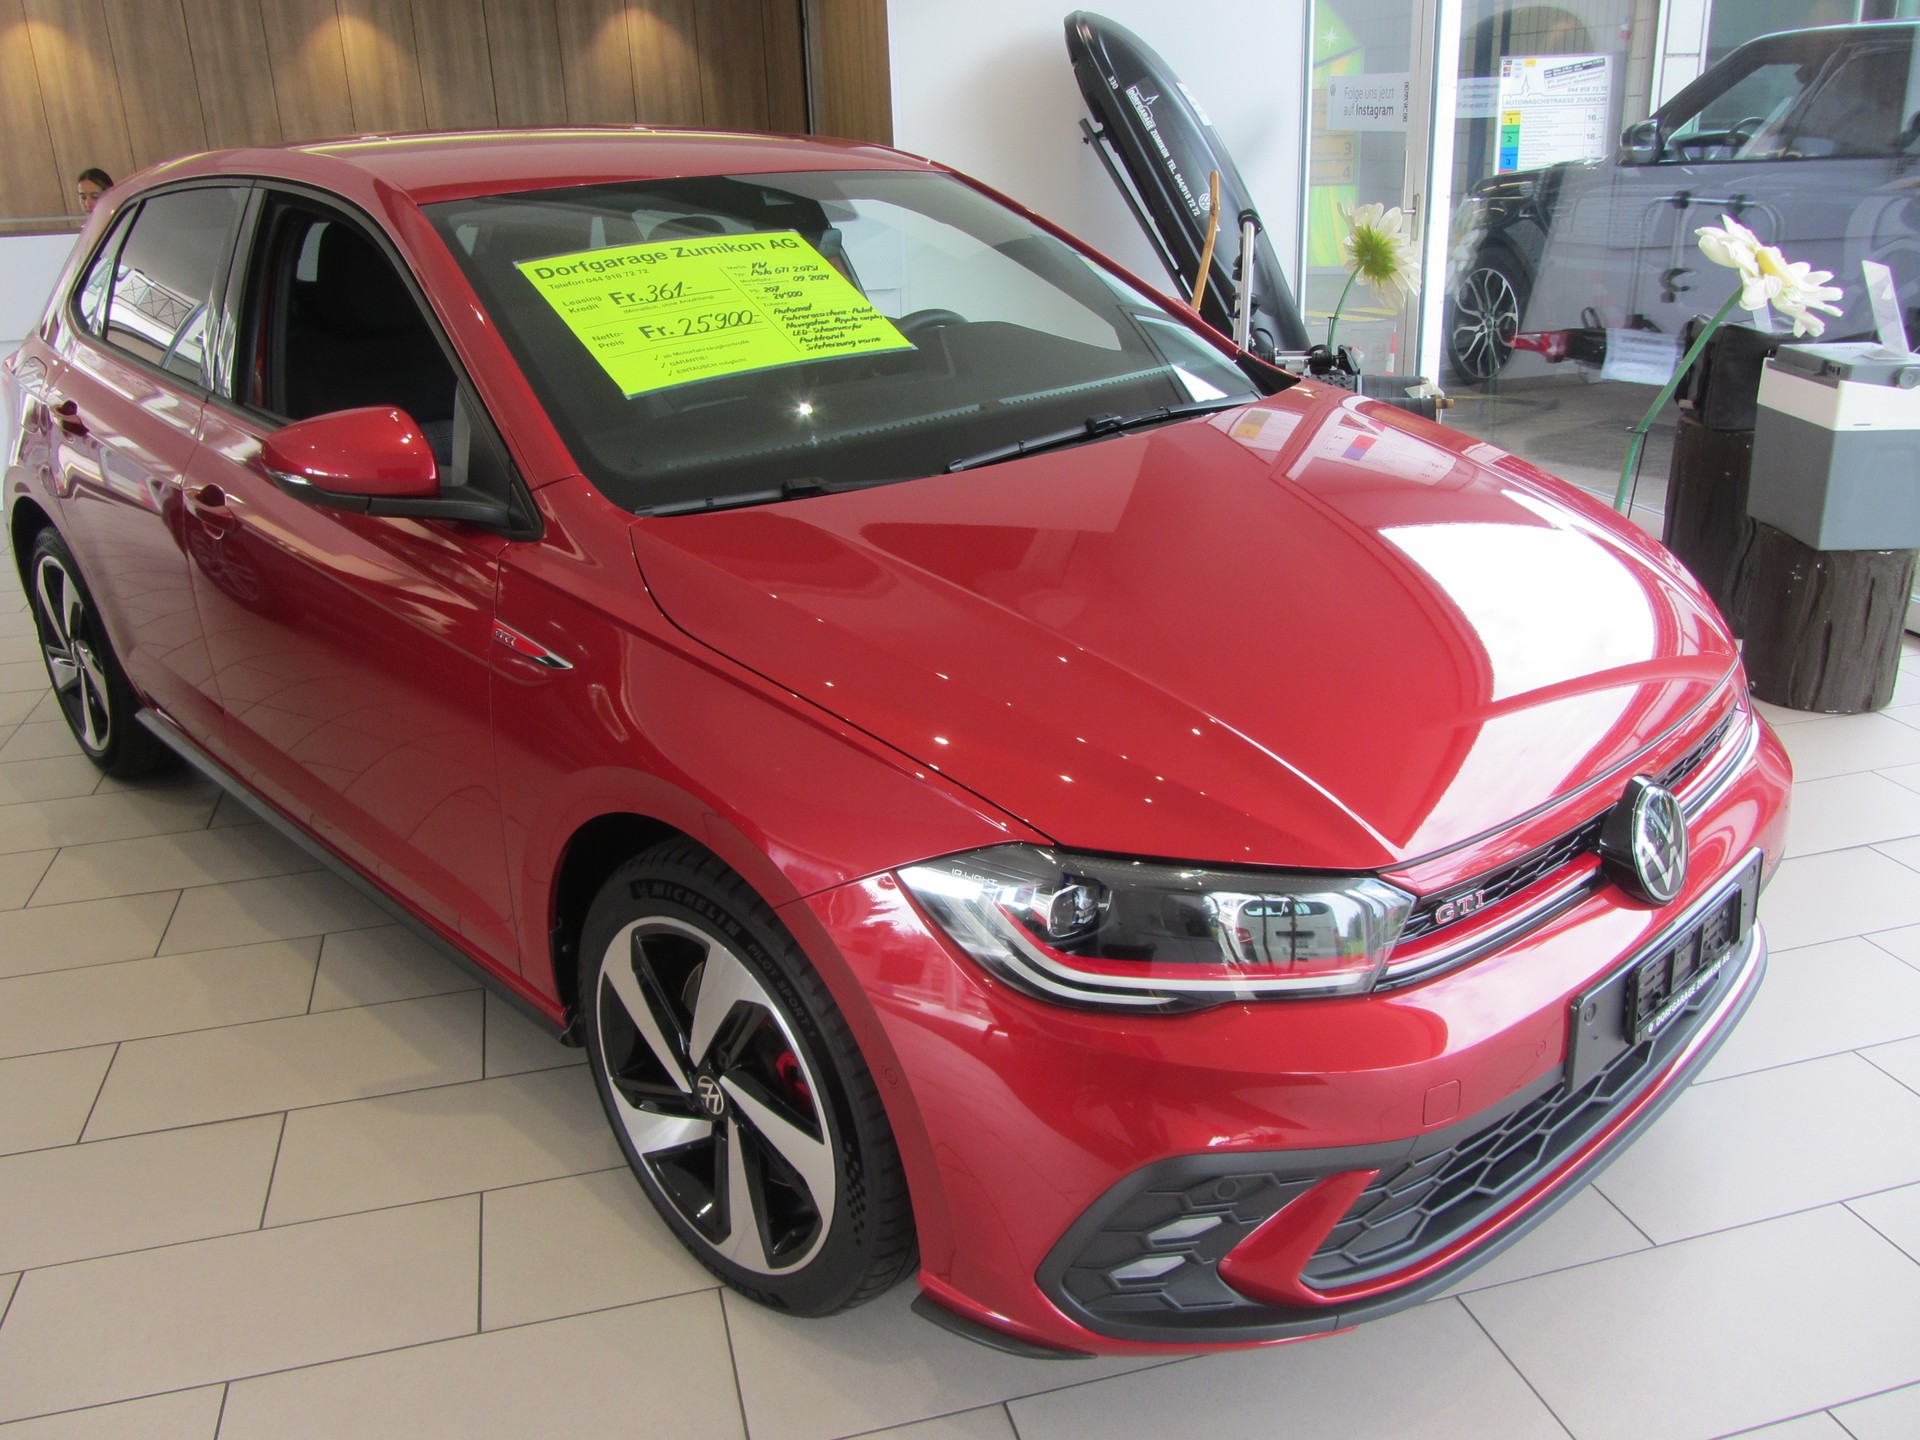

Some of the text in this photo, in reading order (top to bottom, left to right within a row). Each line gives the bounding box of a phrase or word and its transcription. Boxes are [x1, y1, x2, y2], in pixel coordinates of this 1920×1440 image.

[1108, 75, 1119, 90] 330
[1344, 86, 1394, 102] Folge uns jetzt
[1343, 103, 1394, 119] auf Instagram
[1127, 88, 1201, 217] DORFGARAGE ZUMIKON TEL. 044/918 72 72
[1505, 158, 1511, 166] 3
[534, 238, 800, 280] Dorfgarage Zumikon AG
[751, 261, 768, 269] VW
[548, 267, 650, 290] Telefon 044 918 72 72
[751, 268, 772, 276] Polo
[774, 266, 790, 274] GTI
[763, 285, 780, 293] 207
[562, 294, 602, 307] Leasing
[608, 291, 644, 306] Fr.
[568, 304, 600, 314] Kredit
[773, 303, 813, 315] Automat
[786, 318, 830, 330] Navigation
[591, 331, 624, 342] Netto-
[638, 324, 675, 339] Fr.
[598, 339, 625, 350] Preis
[676, 363, 718, 375] EINTAUSCH
[653, 883, 741, 938] MICHELIN
[1435, 889, 1485, 925] GTI
[747, 943, 779, 977] PILOT
